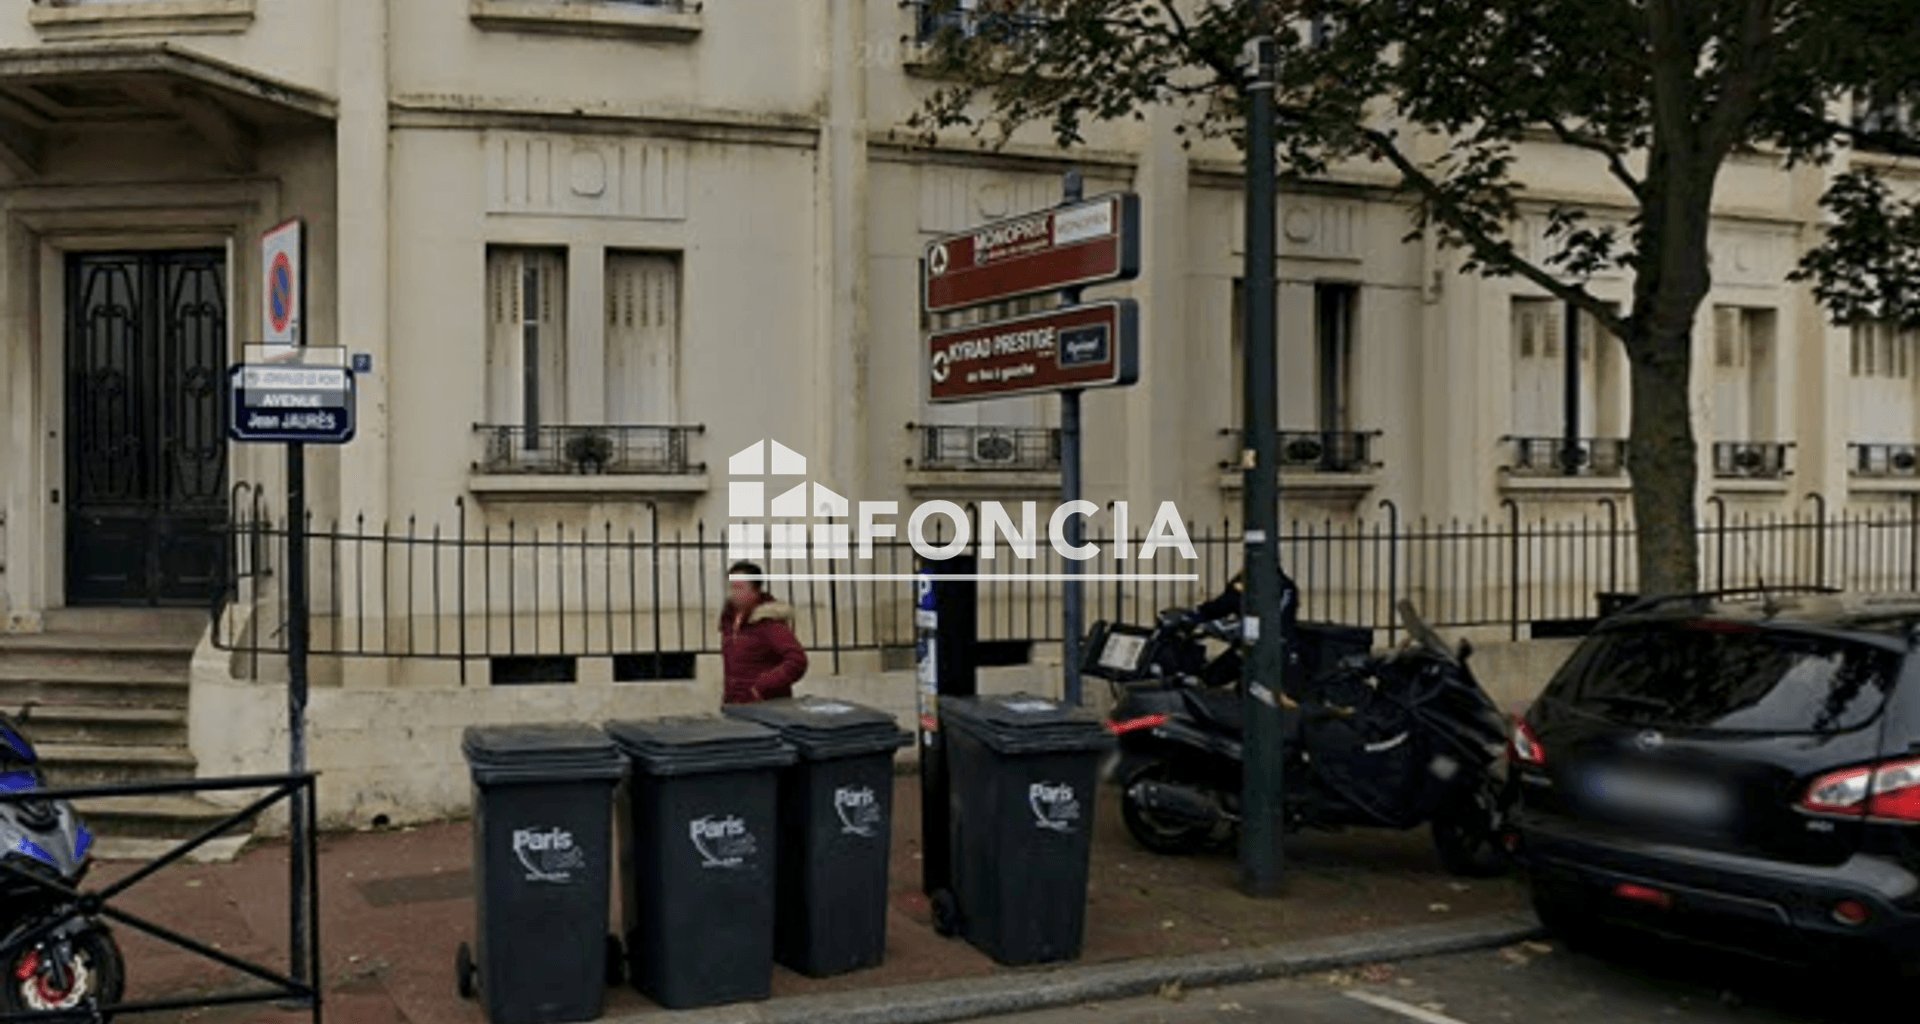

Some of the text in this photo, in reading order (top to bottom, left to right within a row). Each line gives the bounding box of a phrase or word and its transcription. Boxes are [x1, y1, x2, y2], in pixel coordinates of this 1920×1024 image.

[973, 217, 1050, 251] MONOPRIX
[950, 327, 1055, 361] KYRIAD PRESTIGE
[1001, 363, 1036, 382] gauche
[263, 393, 321, 407] AVENUE
[247, 410, 336, 429] Jean JAURÈS
[835, 786, 875, 806] Paris
[1029, 782, 1074, 802] Paris
[690, 815, 745, 839] Paris
[513, 827, 573, 850] Paris
